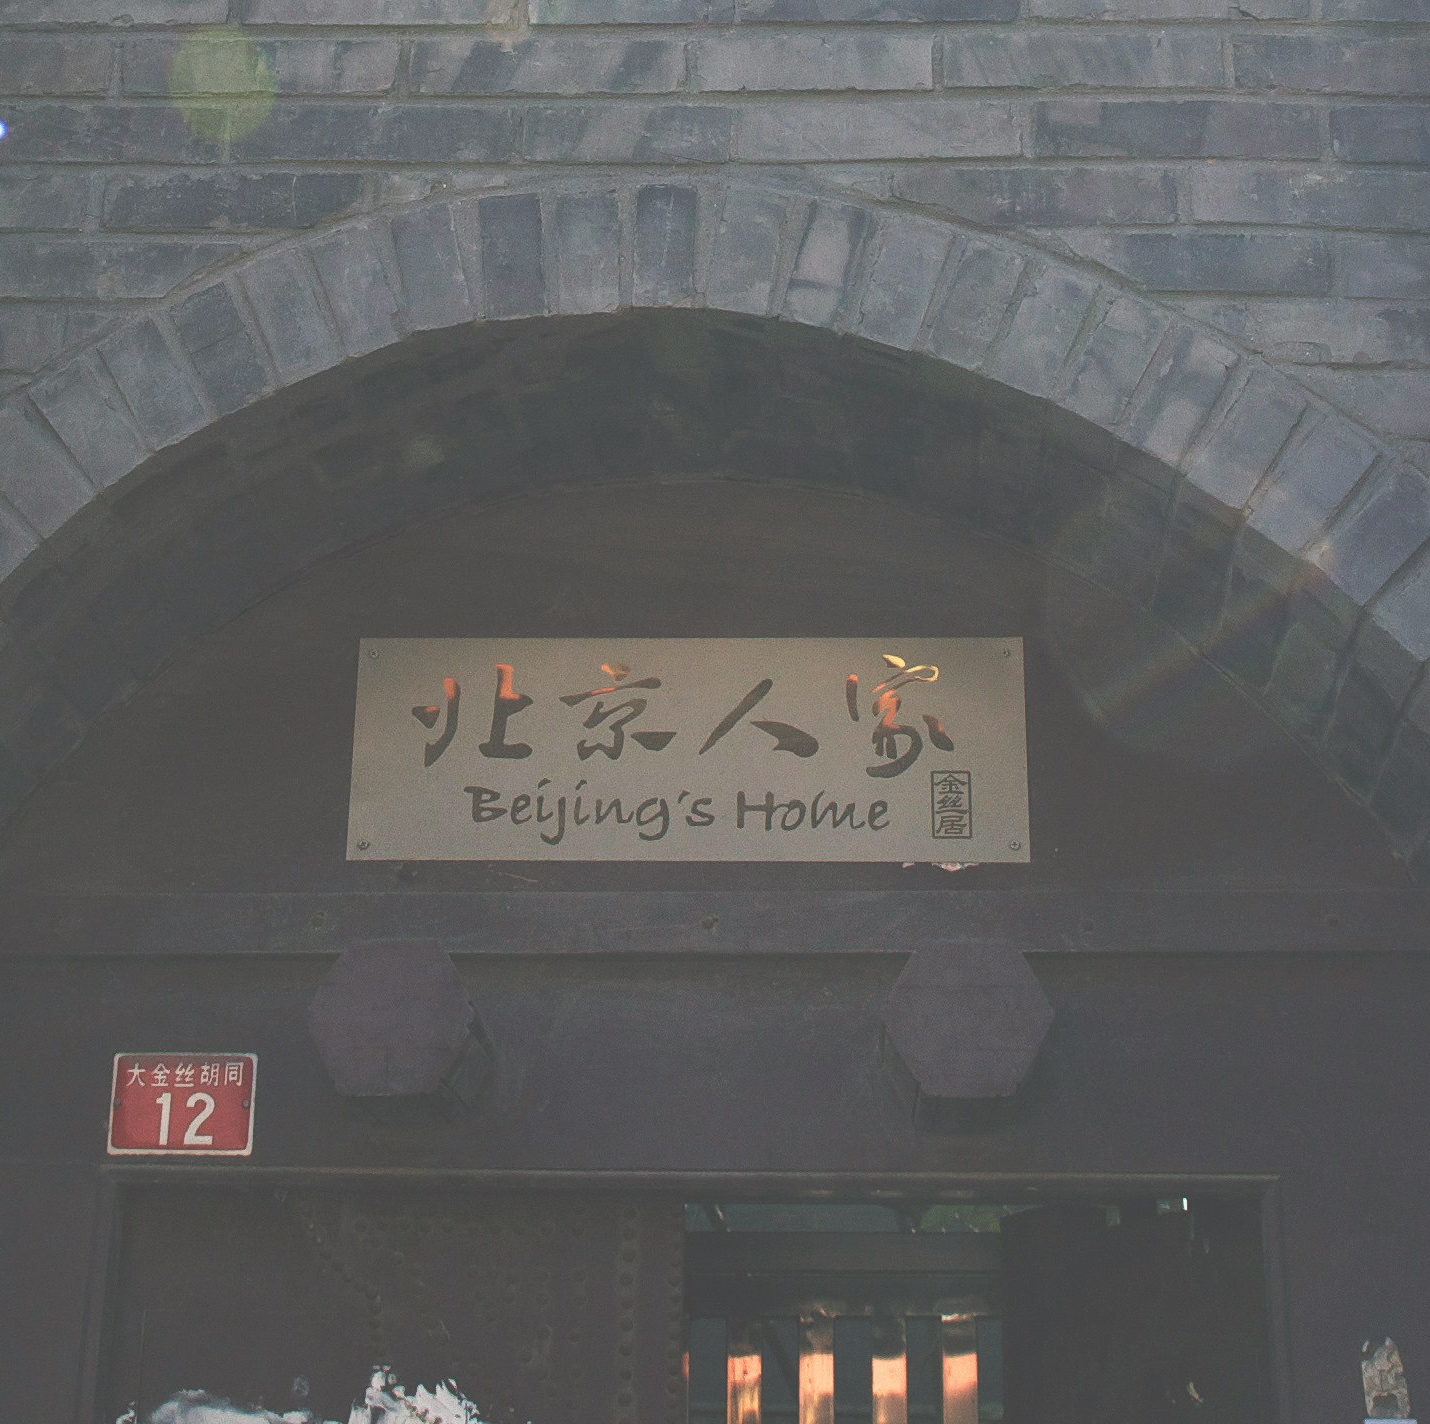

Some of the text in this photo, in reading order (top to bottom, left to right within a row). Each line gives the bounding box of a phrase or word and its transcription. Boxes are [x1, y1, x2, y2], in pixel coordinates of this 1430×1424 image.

[412, 654, 954, 778] 北京人家
[463, 778, 891, 845] Beijing's Home
[934, 773, 969, 835] 金丝居
[126, 1062, 245, 1087] 大金丝胡同
[155, 1092, 215, 1146] 12
